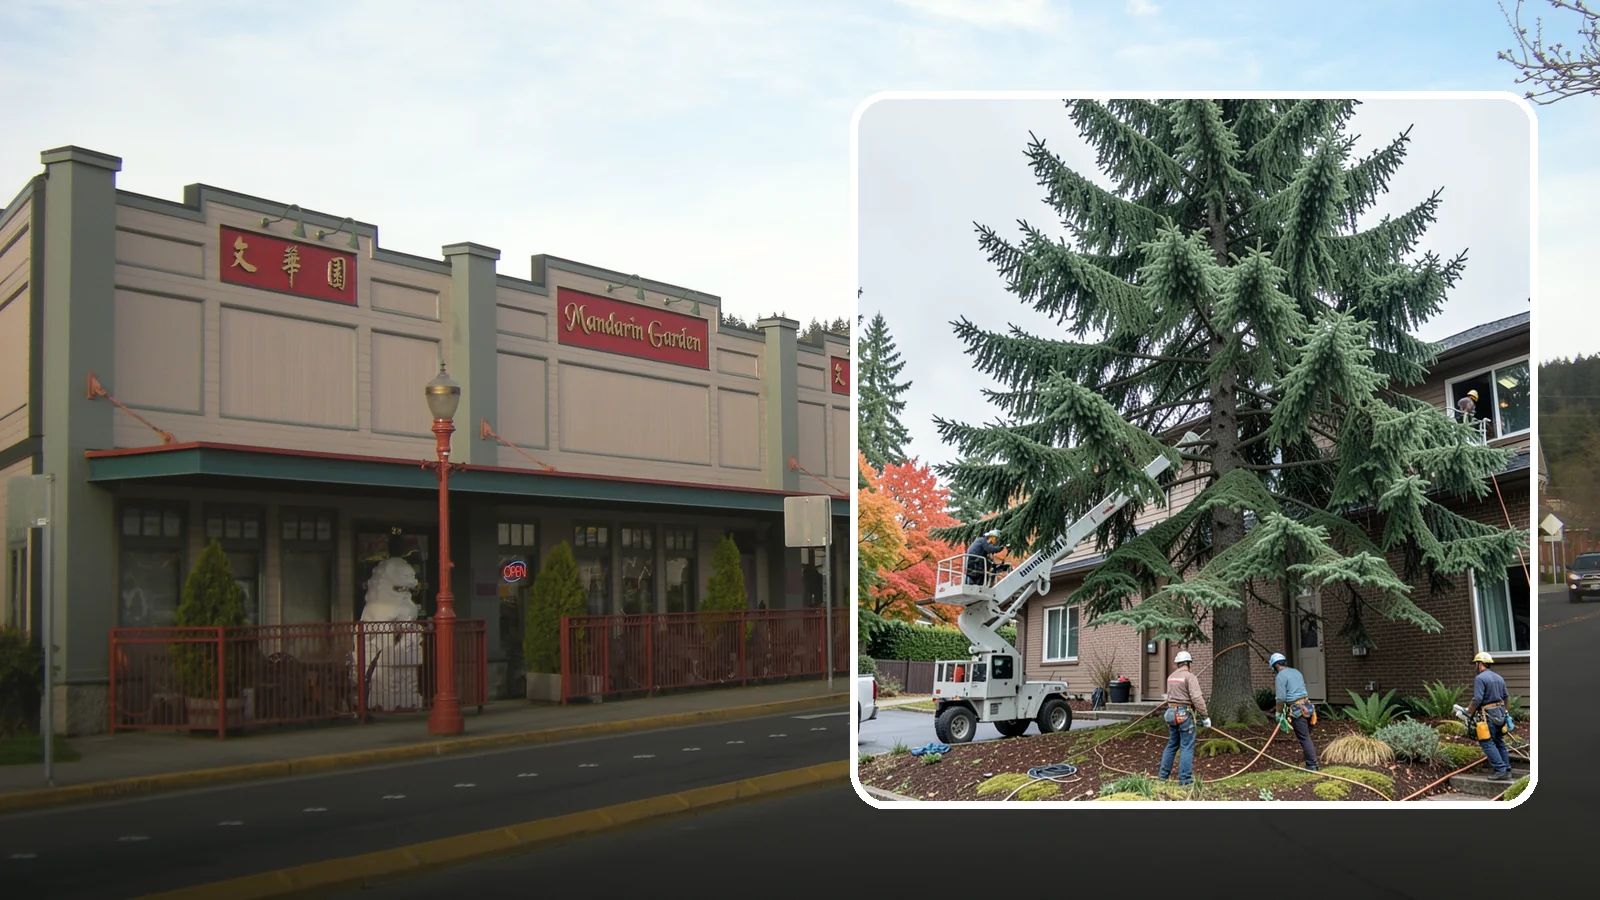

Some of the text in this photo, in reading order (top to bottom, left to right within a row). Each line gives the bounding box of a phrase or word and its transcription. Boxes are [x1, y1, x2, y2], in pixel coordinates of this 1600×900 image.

[231, 236, 346, 290] 文華園
[564, 302, 701, 352] Mandarin Garden
[503, 565, 527, 578] OPEN
